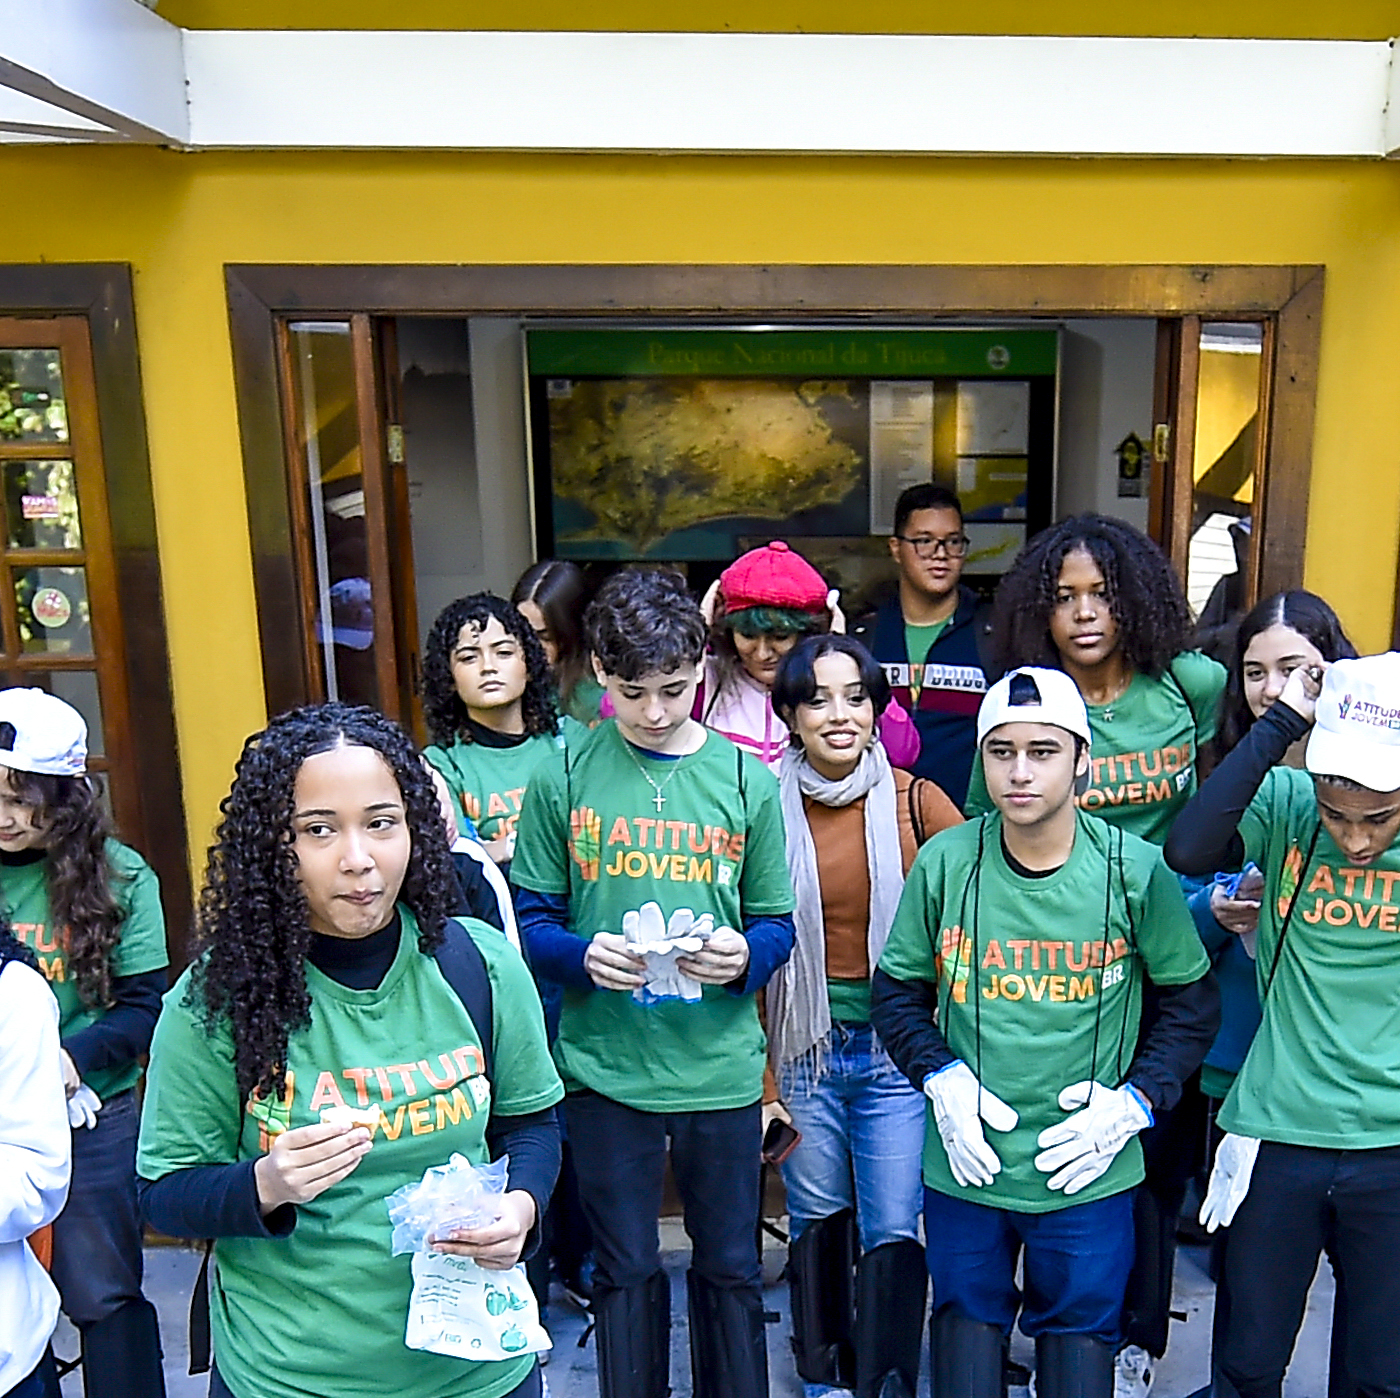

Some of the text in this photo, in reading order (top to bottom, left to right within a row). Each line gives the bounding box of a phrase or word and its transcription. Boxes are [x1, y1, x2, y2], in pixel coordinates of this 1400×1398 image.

[648, 341, 947, 372] Parque Nacional da Tijuca
[1351, 713, 1388, 728] JOVEM
[607, 816, 746, 862] ATITUDE
[606, 850, 712, 884] JOVEM
[982, 964, 1123, 1003] JOVEM BR
